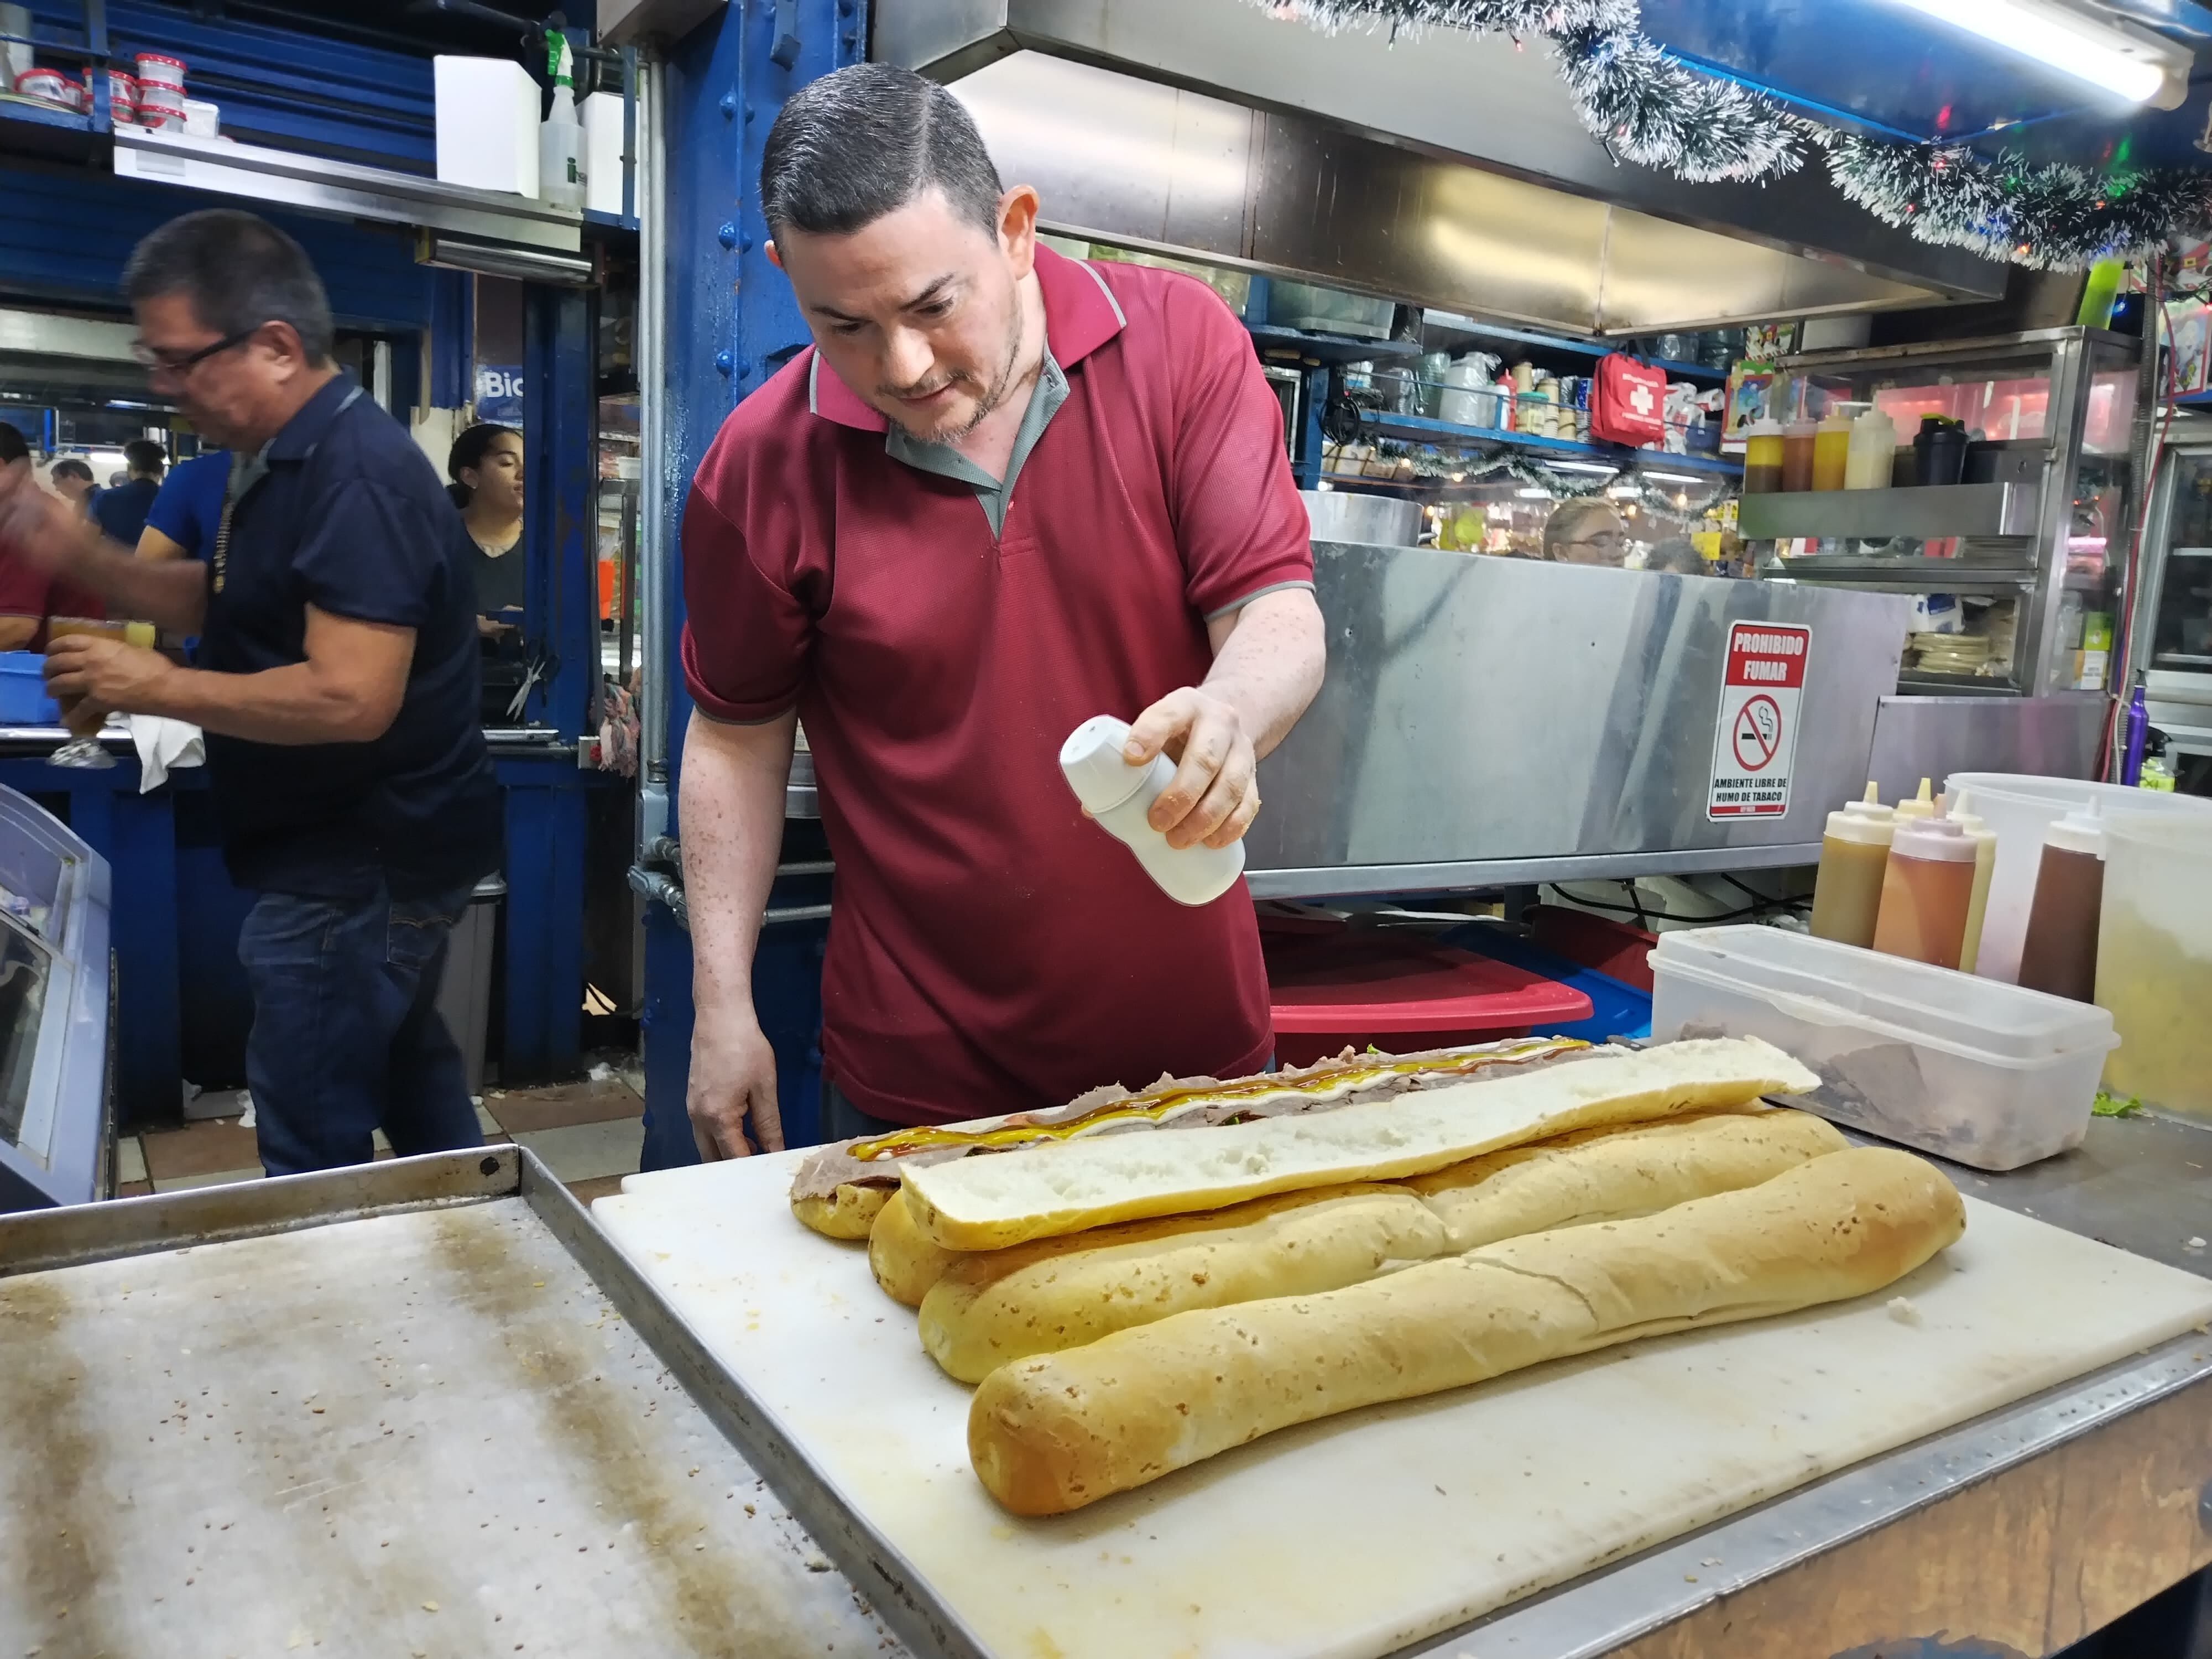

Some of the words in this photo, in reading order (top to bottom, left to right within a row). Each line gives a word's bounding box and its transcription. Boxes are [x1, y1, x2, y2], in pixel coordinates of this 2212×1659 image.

[1734, 633, 1804, 656] PROHIBIDO
[1744, 660, 1787, 681] FUMAR
[1714, 779, 1753, 788] AMBIENTE
[1755, 779, 1776, 787] LIBRE
[1777, 778, 1787, 787] DE
[1717, 792, 1739, 802] HUMO
[1741, 792, 1751, 801] DE
[1752, 792, 1782, 801] TABACO
